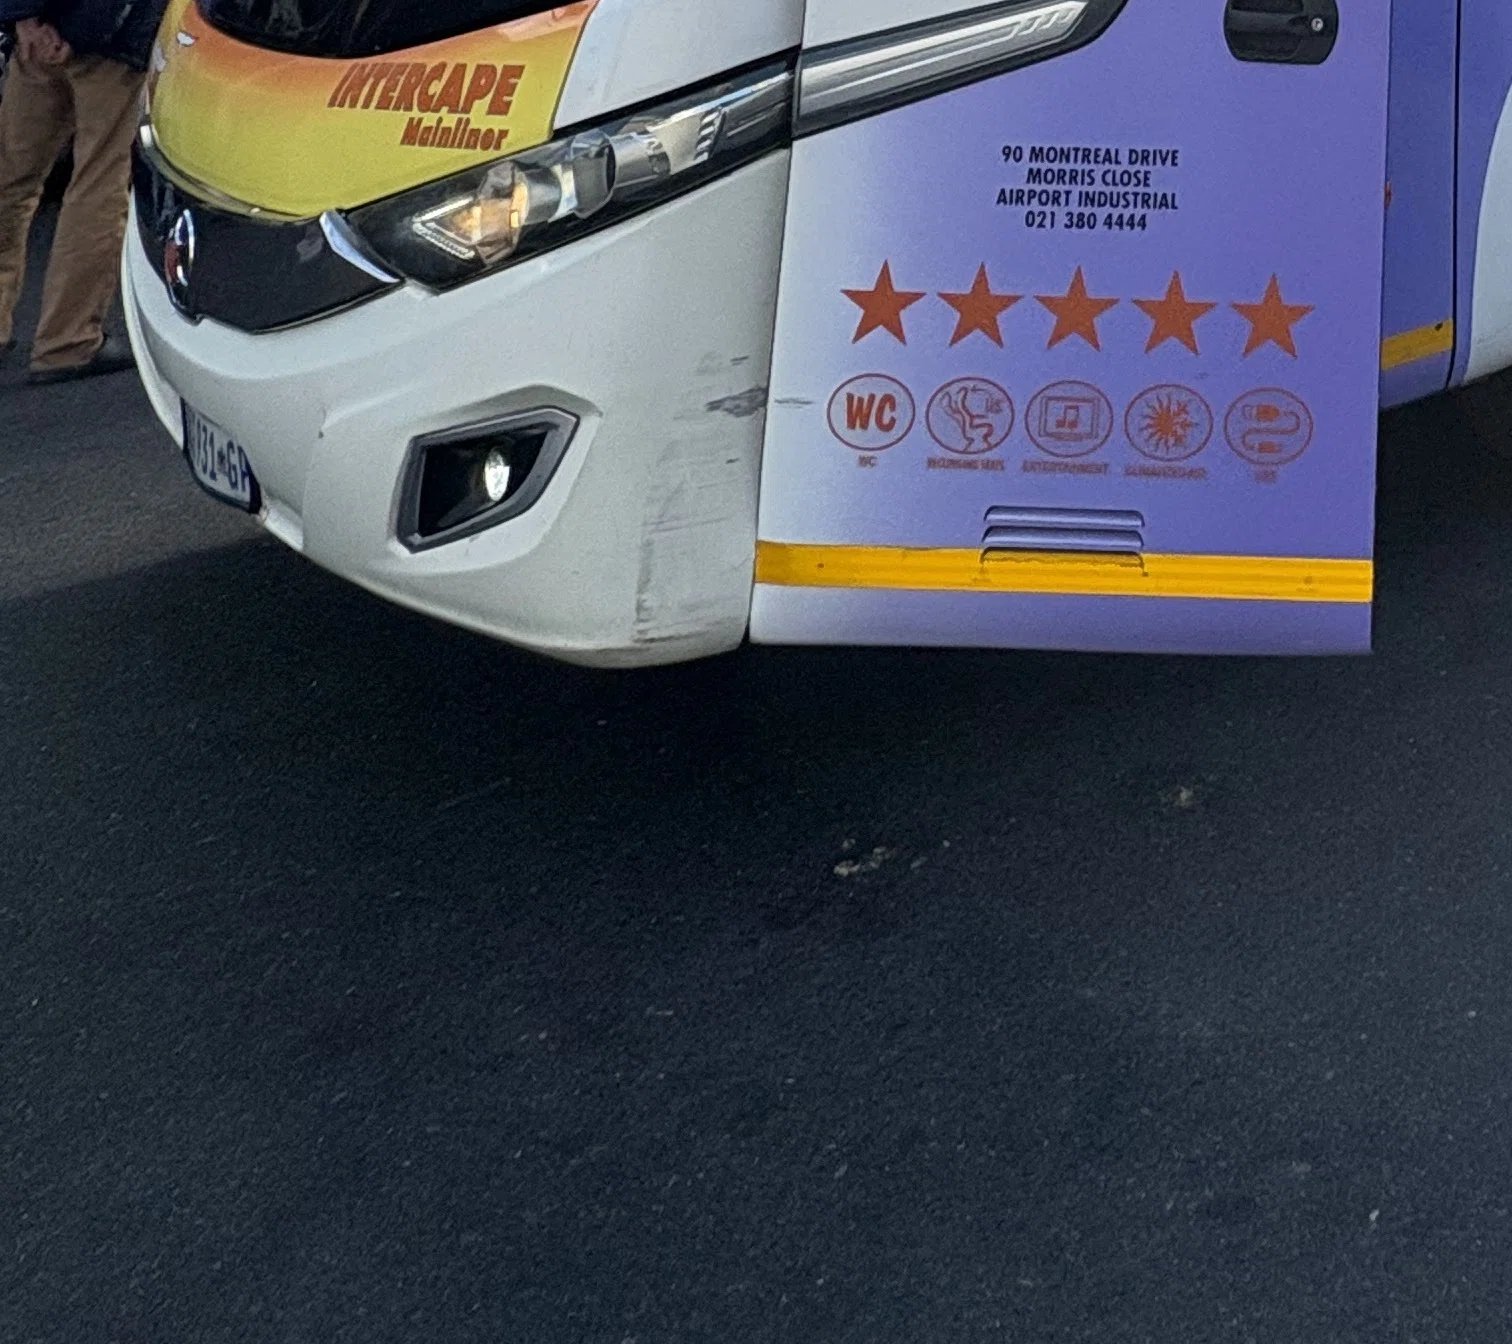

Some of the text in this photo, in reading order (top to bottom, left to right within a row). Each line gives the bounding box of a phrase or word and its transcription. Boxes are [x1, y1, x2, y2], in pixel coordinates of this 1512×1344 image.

[327, 62, 526, 116] INTERCAPE
[400, 116, 509, 151] Mainliner
[1002, 145, 1179, 167] 90 MONTREAL DRIVE
[1026, 168, 1152, 188] MORRIS CLOSE
[996, 188, 1178, 210] AIRPORT INDUSTRIAL
[1024, 210, 1147, 231] 021 380 4444
[846, 392, 897, 433] WC
